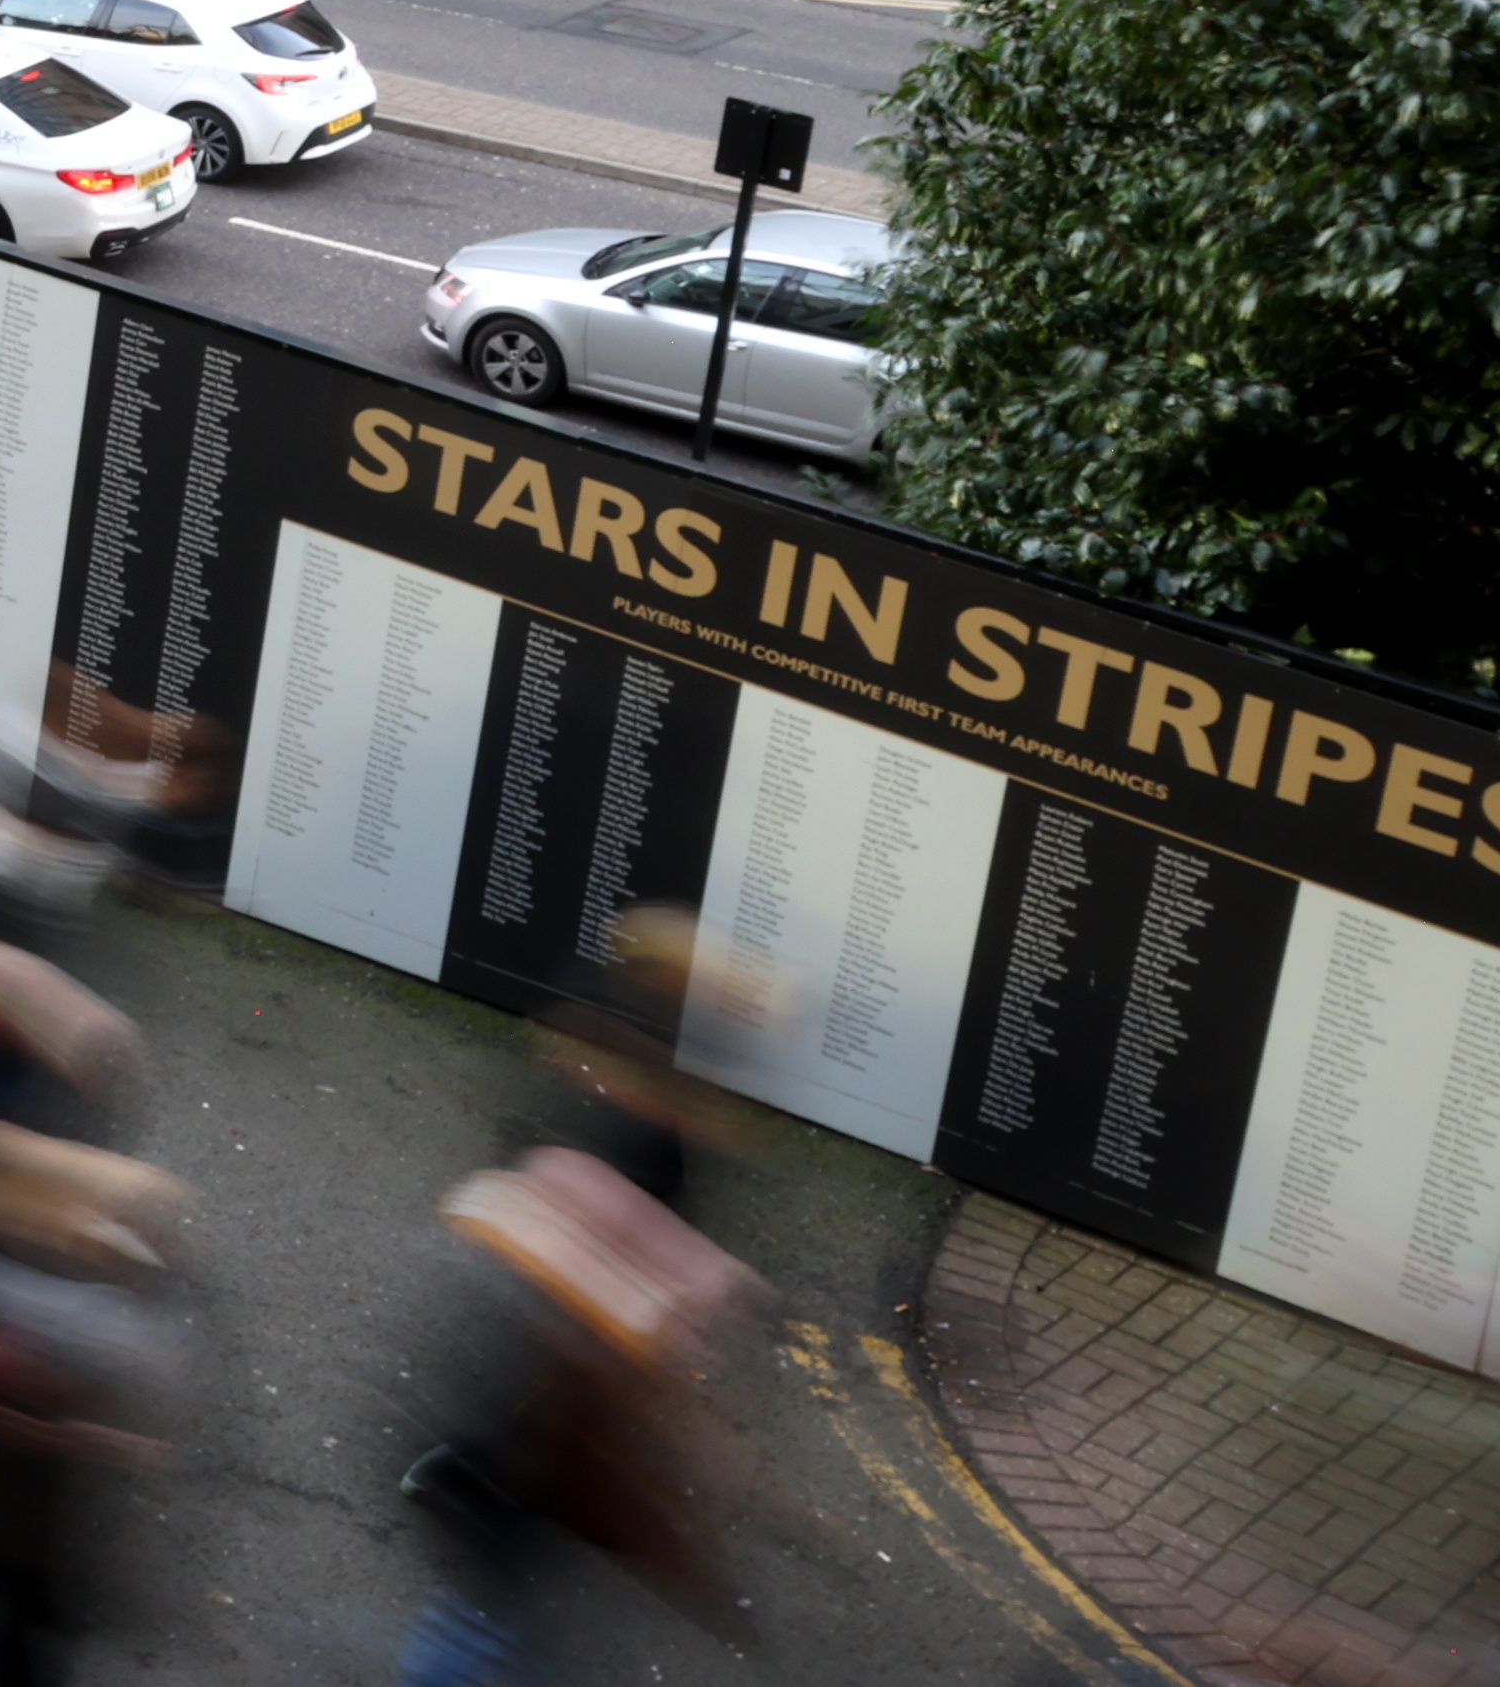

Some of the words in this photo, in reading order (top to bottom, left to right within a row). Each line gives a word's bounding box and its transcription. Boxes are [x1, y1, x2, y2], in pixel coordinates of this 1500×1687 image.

[346, 407, 721, 598] STARS
[758, 538, 909, 665] IN
[612, 594, 691, 634] PLAYERS
[697, 624, 747, 653] WITH
[750, 644, 882, 701] COMPETITIVE
[886, 690, 943, 720] FIRST
[947, 711, 1006, 743] TEAM
[1008, 734, 1168, 800] APPEARANCES
